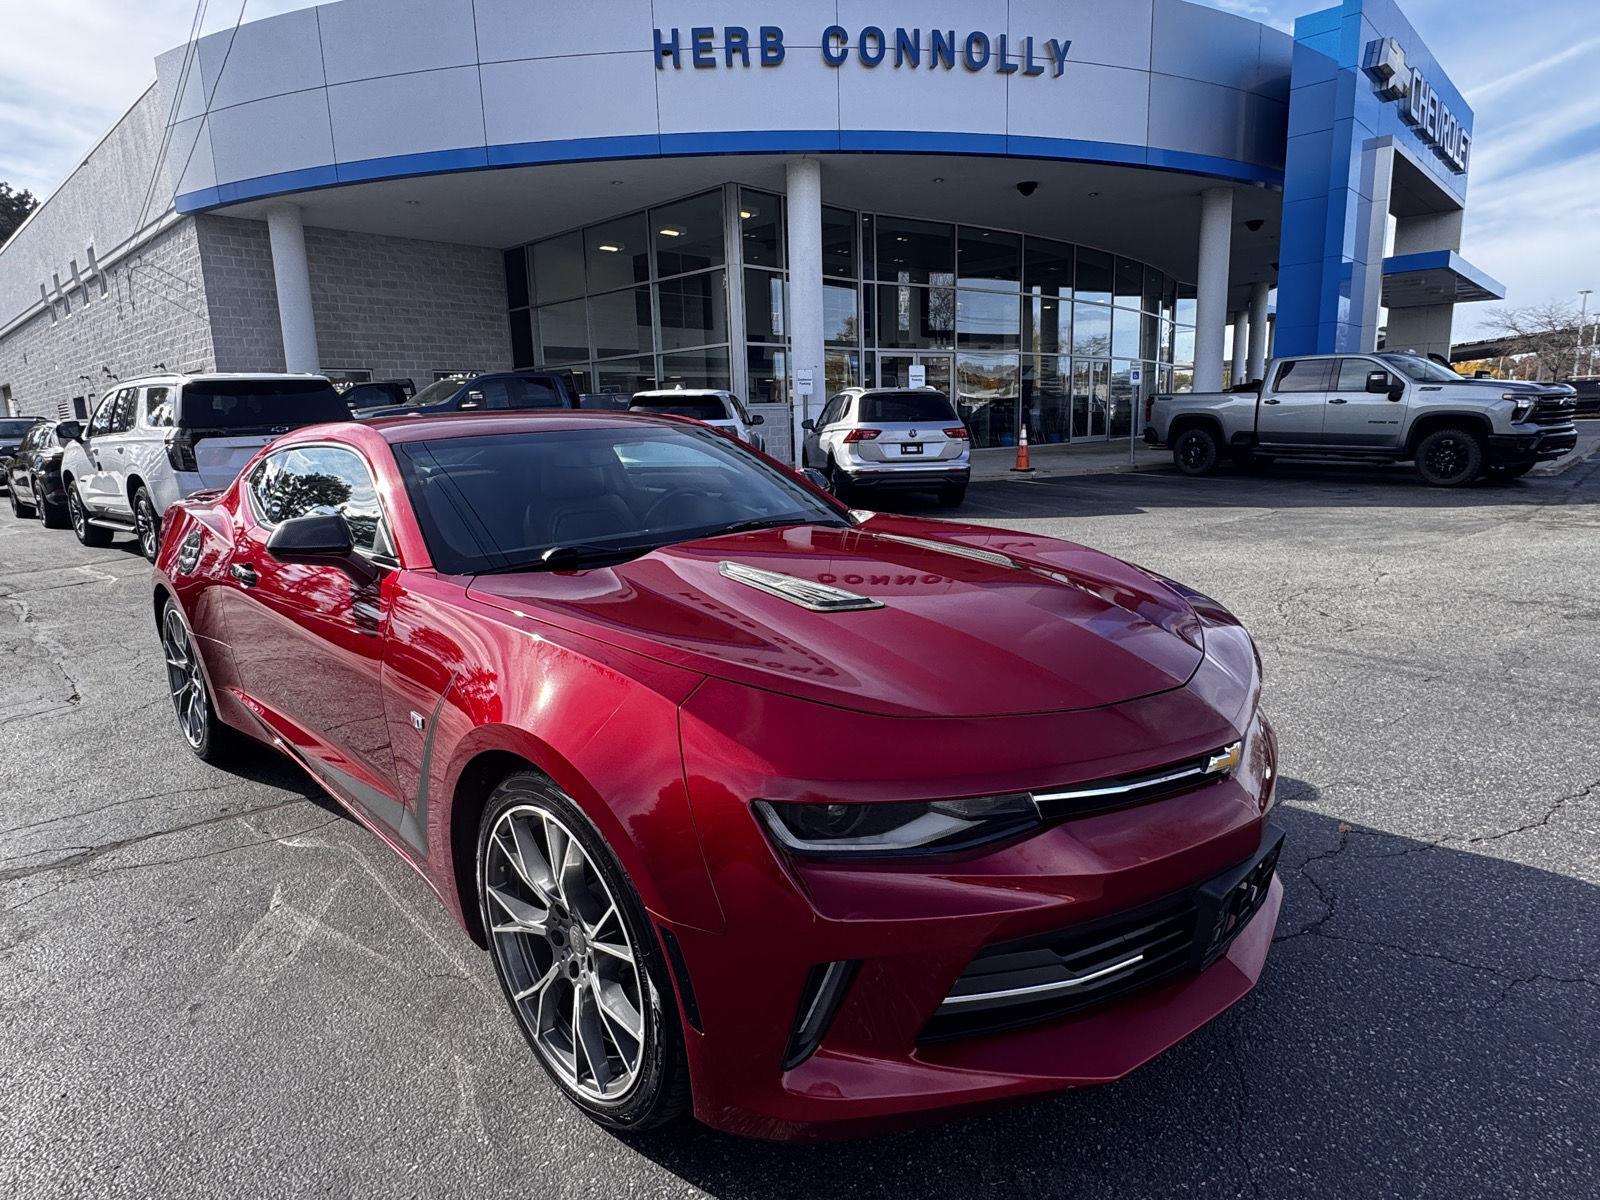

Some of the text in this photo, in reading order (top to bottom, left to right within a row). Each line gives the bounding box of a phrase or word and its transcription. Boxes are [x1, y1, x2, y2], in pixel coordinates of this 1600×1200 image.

[653, 25, 1072, 78] HERB CONNOLLY
[1407, 67, 1472, 174] CHEVROLET
